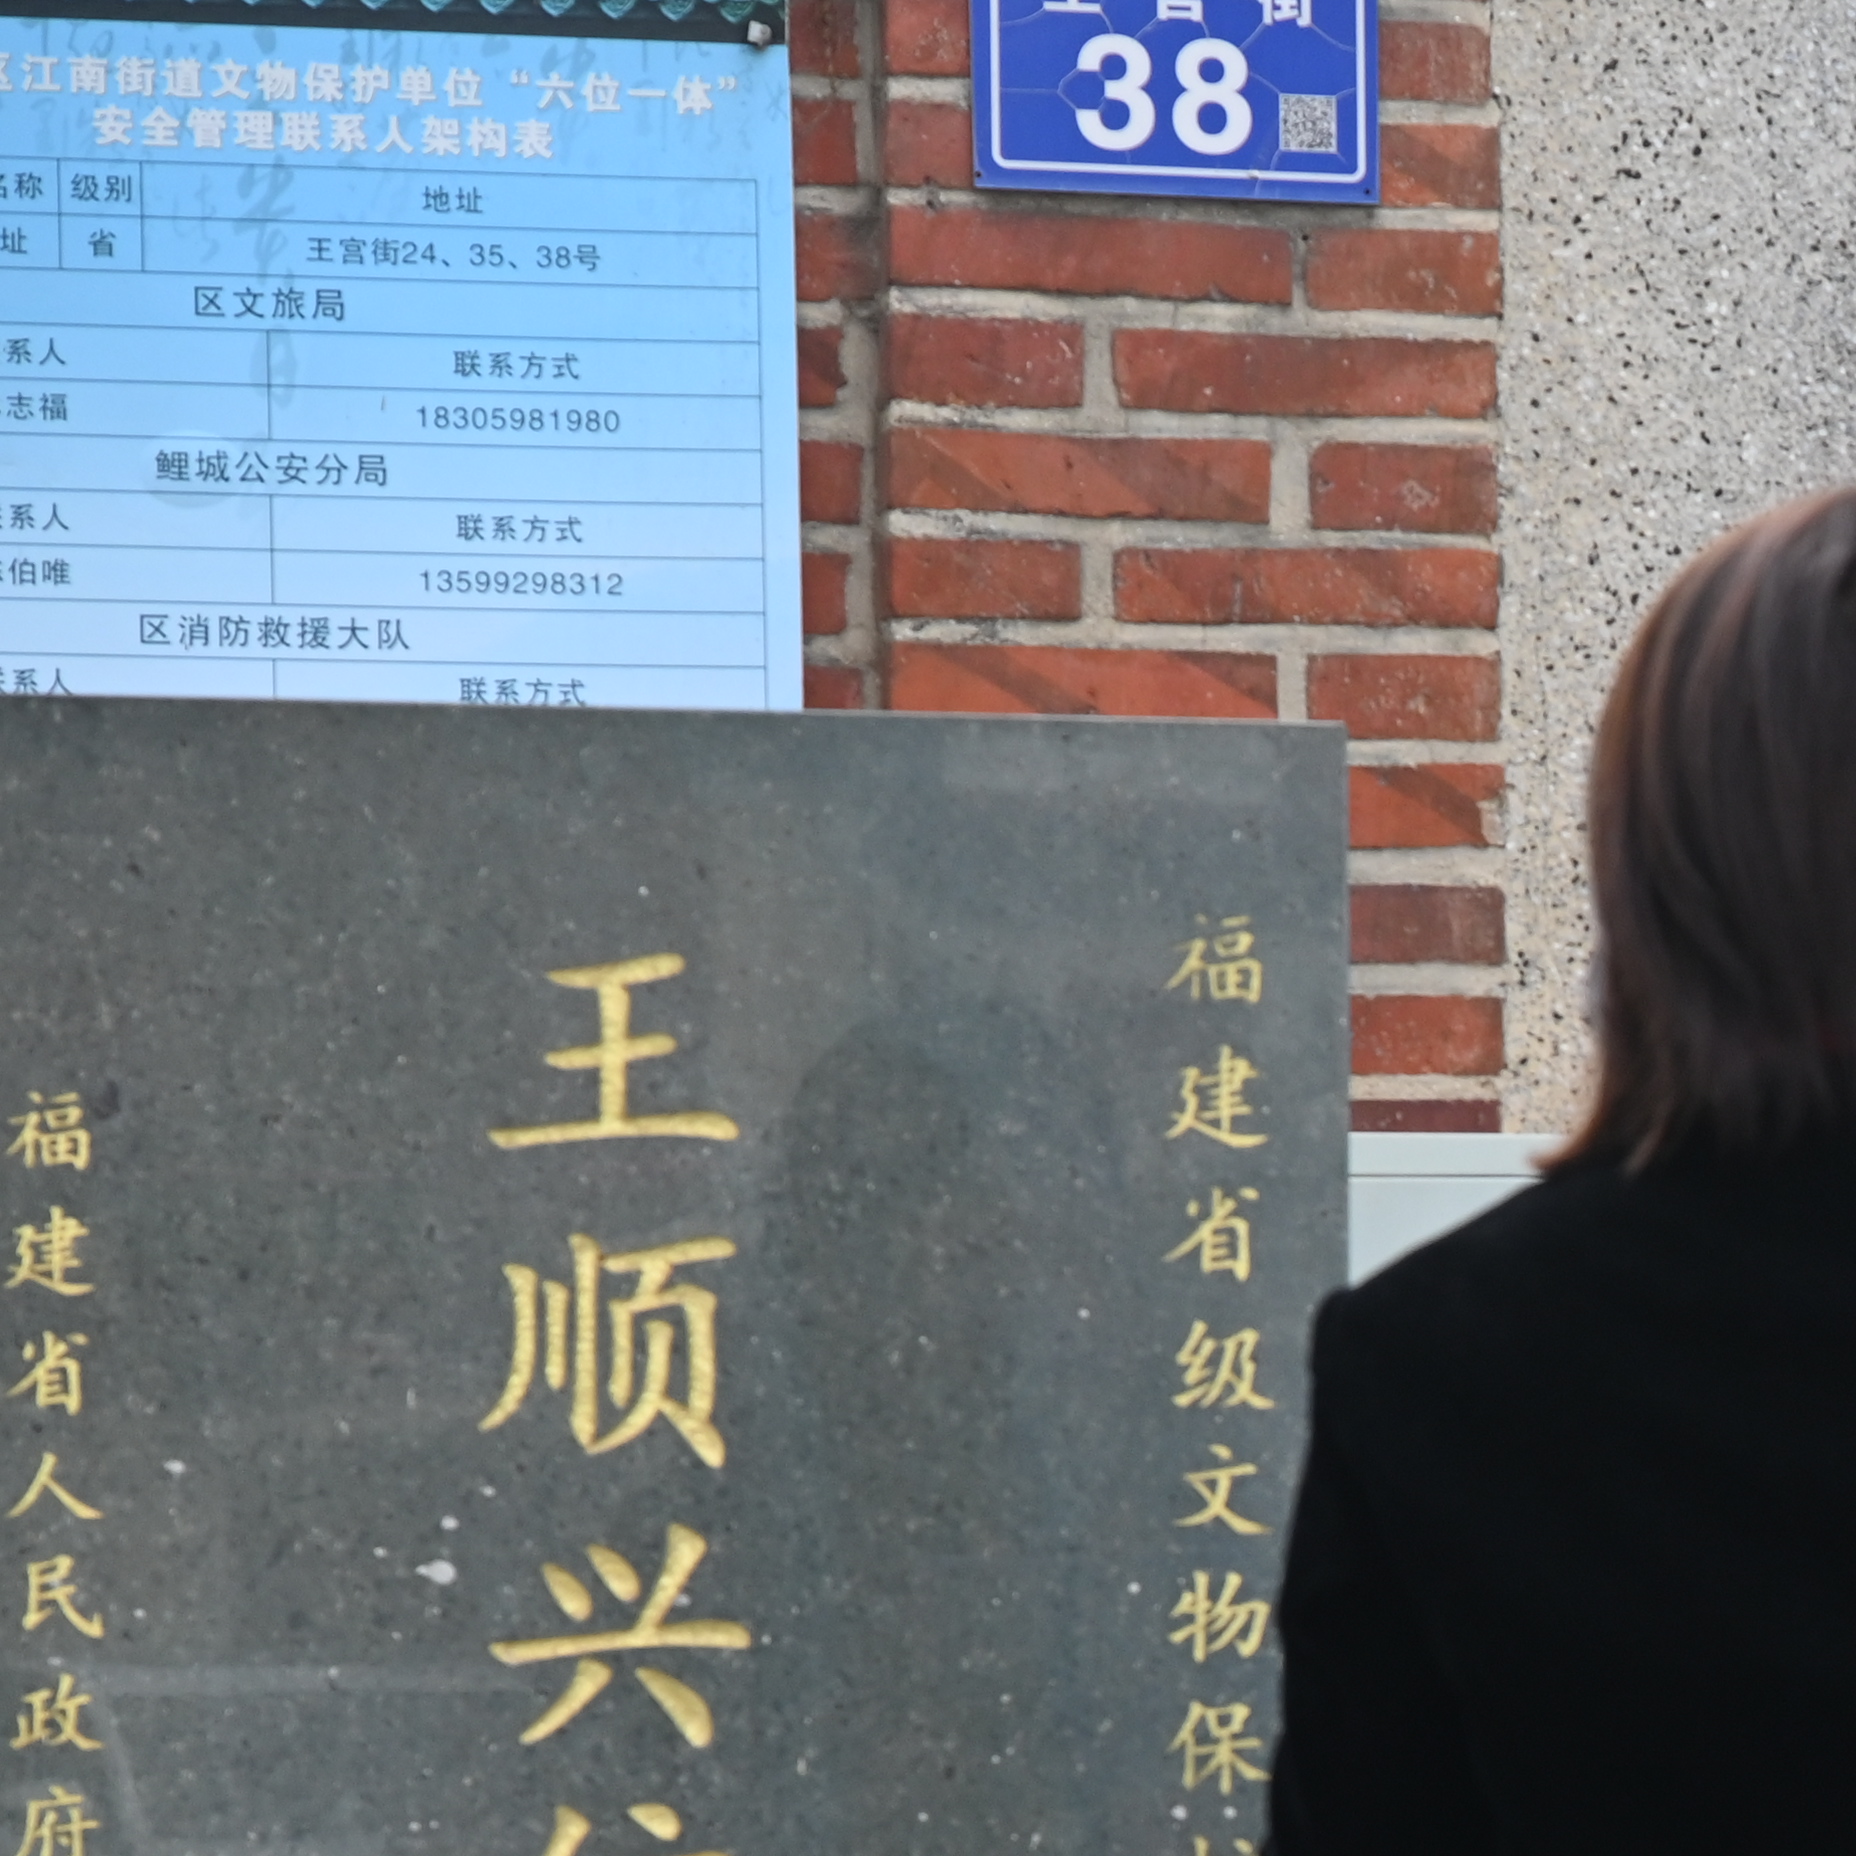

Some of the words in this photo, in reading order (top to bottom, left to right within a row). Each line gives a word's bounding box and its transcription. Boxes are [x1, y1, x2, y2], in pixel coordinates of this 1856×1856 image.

[1075, 33, 1252, 155] 38
[93, 104, 554, 159] 安全管理联系人架构表
[0, 170, 44, 200] 称
[70, 172, 133, 202] 级别
[422, 184, 484, 215] 地址
[88, 228, 116, 257] 省
[306, 236, 601, 272] 王宫街24、35、38号
[193, 285, 346, 322] 区文旅局
[3, 337, 66, 366] 系人
[453, 350, 580, 380] 联系方式
[0, 392, 68, 421] 志福
[416, 405, 621, 434] 18305981980
[155, 448, 389, 487] 鲤城公安分局
[0, 502, 69, 531] 系人
[456, 513, 583, 543] 联系方式
[0, 557, 71, 586] 伯唯
[419, 568, 624, 597] 13599298312
[139, 613, 410, 651] 区消防救援大队
[0, 667, 73, 696] 系人
[459, 676, 586, 706] 联系方式
